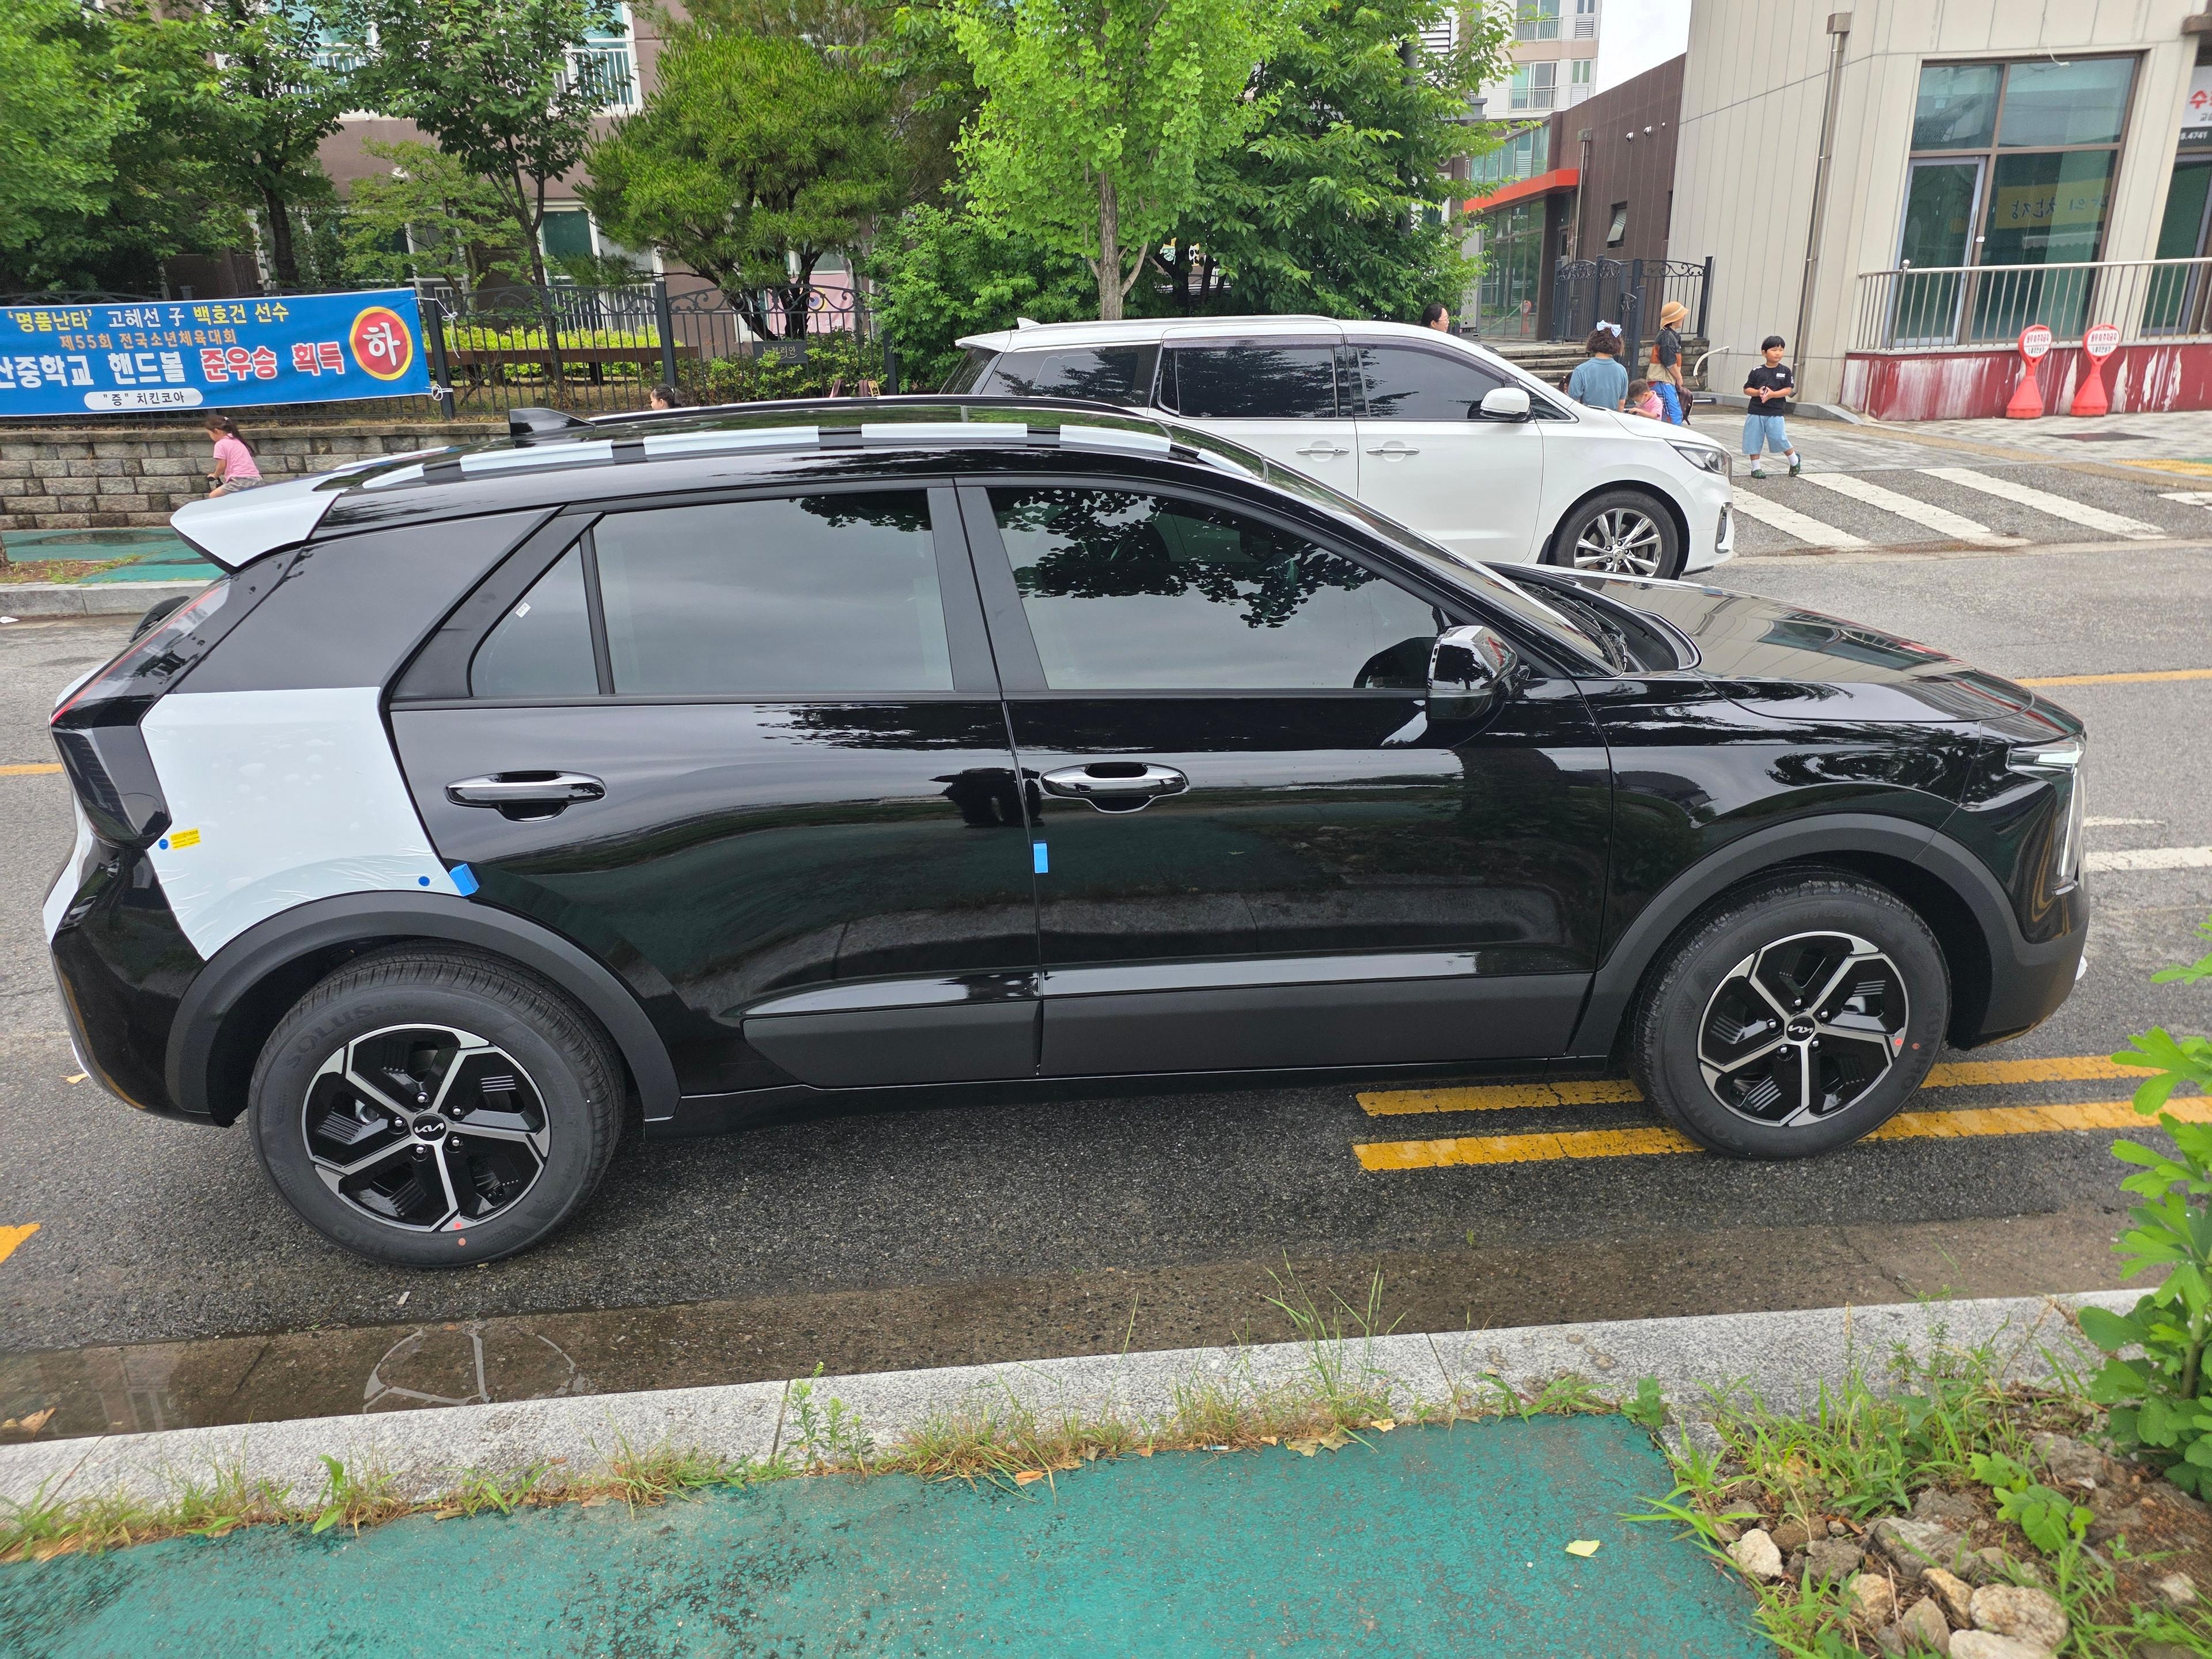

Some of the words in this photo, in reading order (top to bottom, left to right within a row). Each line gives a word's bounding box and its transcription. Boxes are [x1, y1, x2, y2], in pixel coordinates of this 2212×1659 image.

[2190, 90, 2212, 109] 수
[107, 308, 161, 328] 고혜선
[193, 304, 248, 325] 백호건
[255, 302, 289, 323] 선수
[59, 333, 113, 351] 제55회
[119, 328, 237, 350] 전국소년체육대회
[362, 322, 400, 366] 하
[108, 351, 186, 385] 핸드볼
[200, 346, 278, 382] 준우승
[291, 341, 344, 376] 획득
[137, 391, 185, 405] 치킨코아
